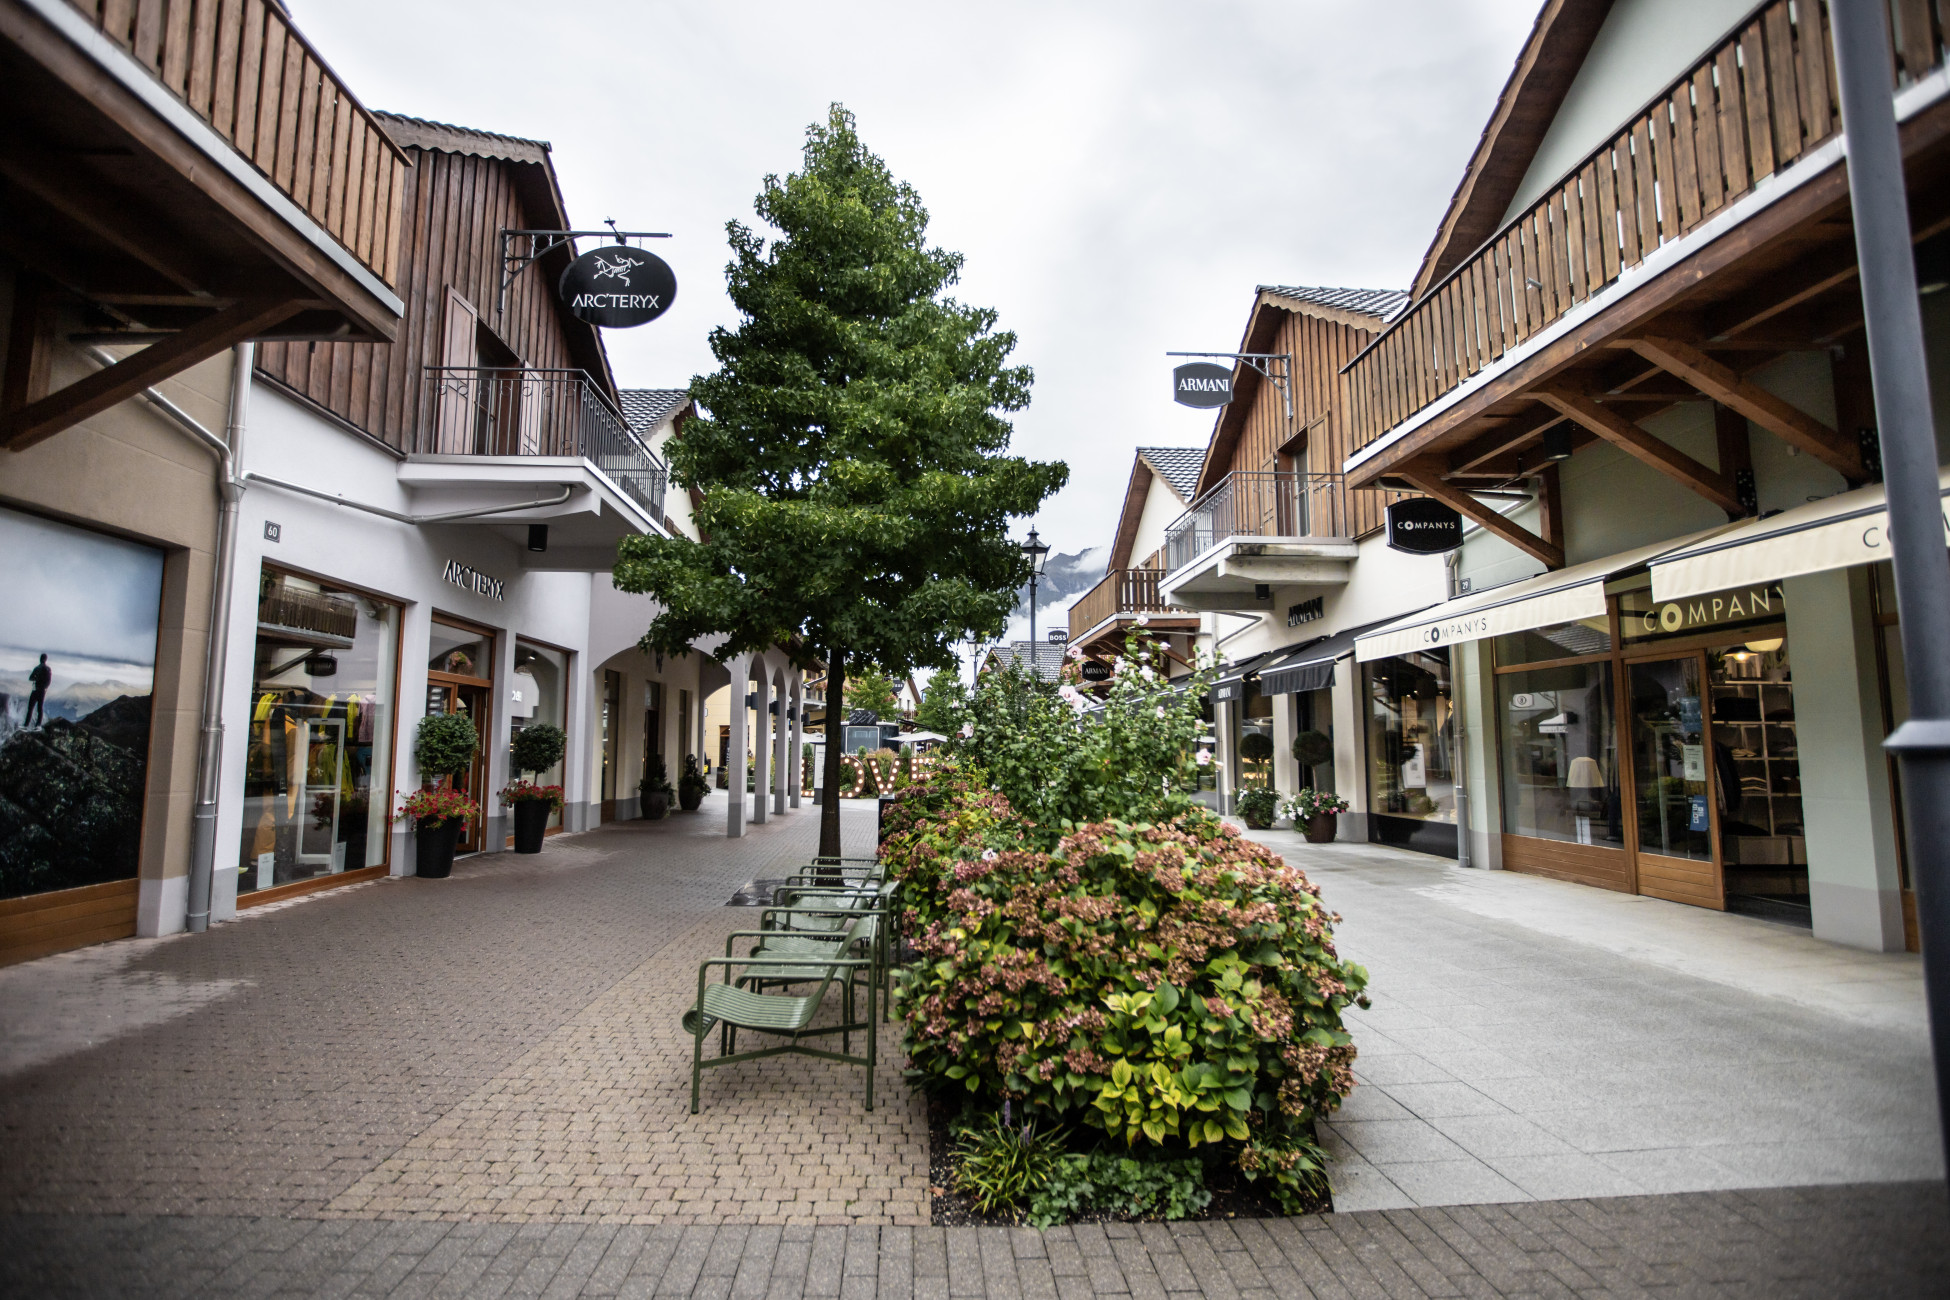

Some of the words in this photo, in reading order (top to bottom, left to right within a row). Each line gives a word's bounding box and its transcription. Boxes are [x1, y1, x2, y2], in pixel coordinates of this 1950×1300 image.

[571, 293, 660, 309] ARC'TERYX
[1178, 377, 1230, 392] ARMANI
[268, 525, 278, 537] 60
[1397, 520, 1455, 531] COMPANYS
[1423, 617, 1487, 643] COMPANYS
